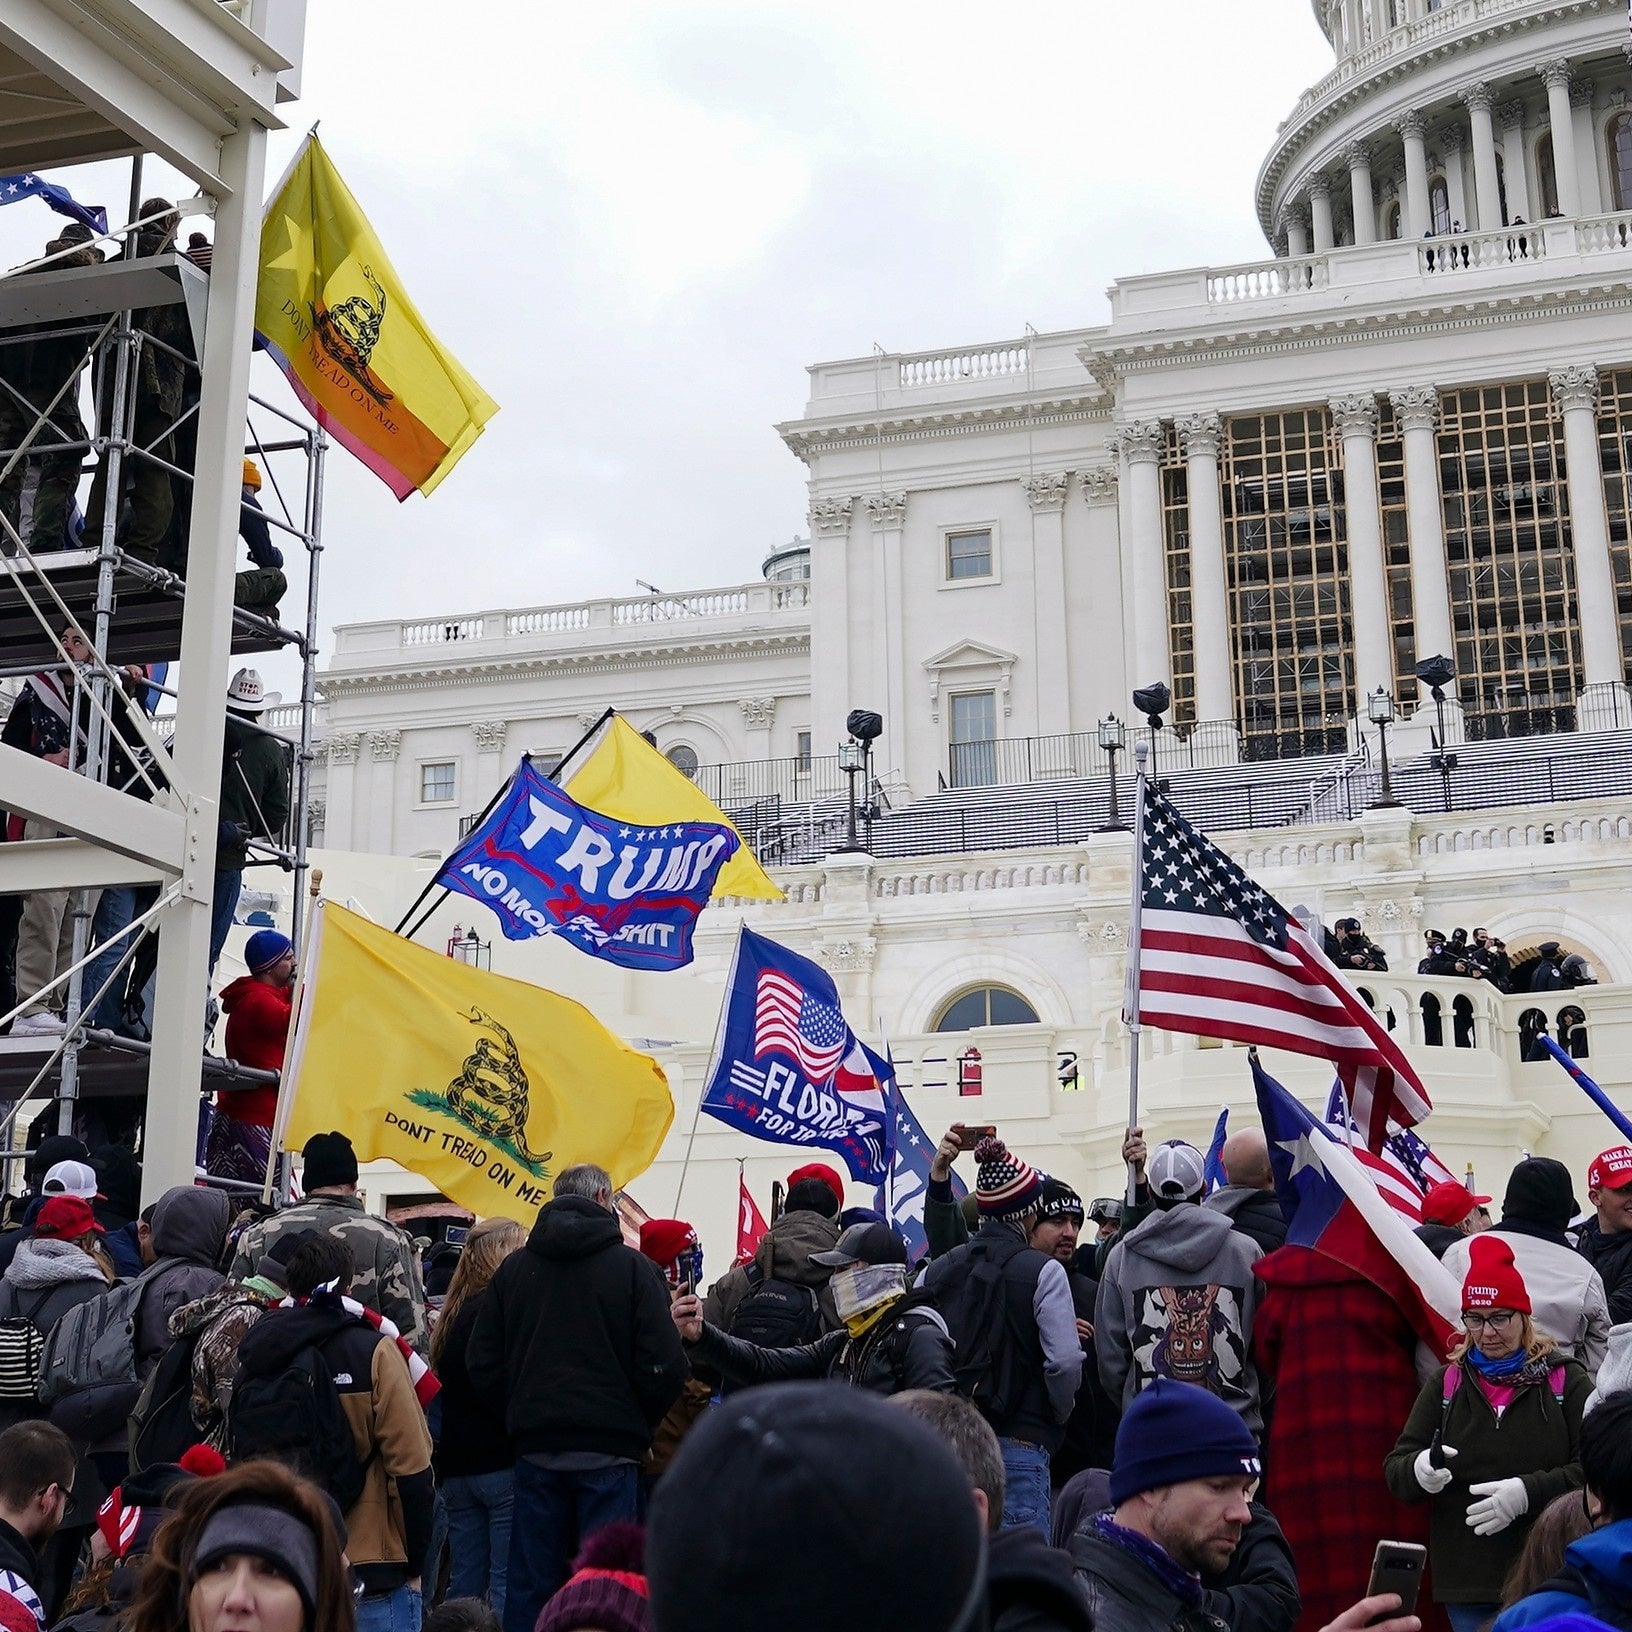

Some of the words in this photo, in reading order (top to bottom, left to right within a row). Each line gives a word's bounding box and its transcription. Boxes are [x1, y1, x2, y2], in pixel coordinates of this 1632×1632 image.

[308, 342, 350, 389] TREAD
[350, 388, 375, 412] ON
[375, 411, 399, 435] ME
[520, 794, 726, 899] TRUMP
[461, 863, 507, 896] NO
[755, 1107, 795, 1136] FOR
[384, 1112, 435, 1143] DONT
[442, 1133, 487, 1167] TREAD
[488, 1162, 516, 1189] ON
[516, 1181, 546, 1206] ME
[1601, 1149, 1623, 1163] MAKE
[1609, 1159, 1632, 1172] GREAT
[1468, 1286, 1499, 1299] Trump
